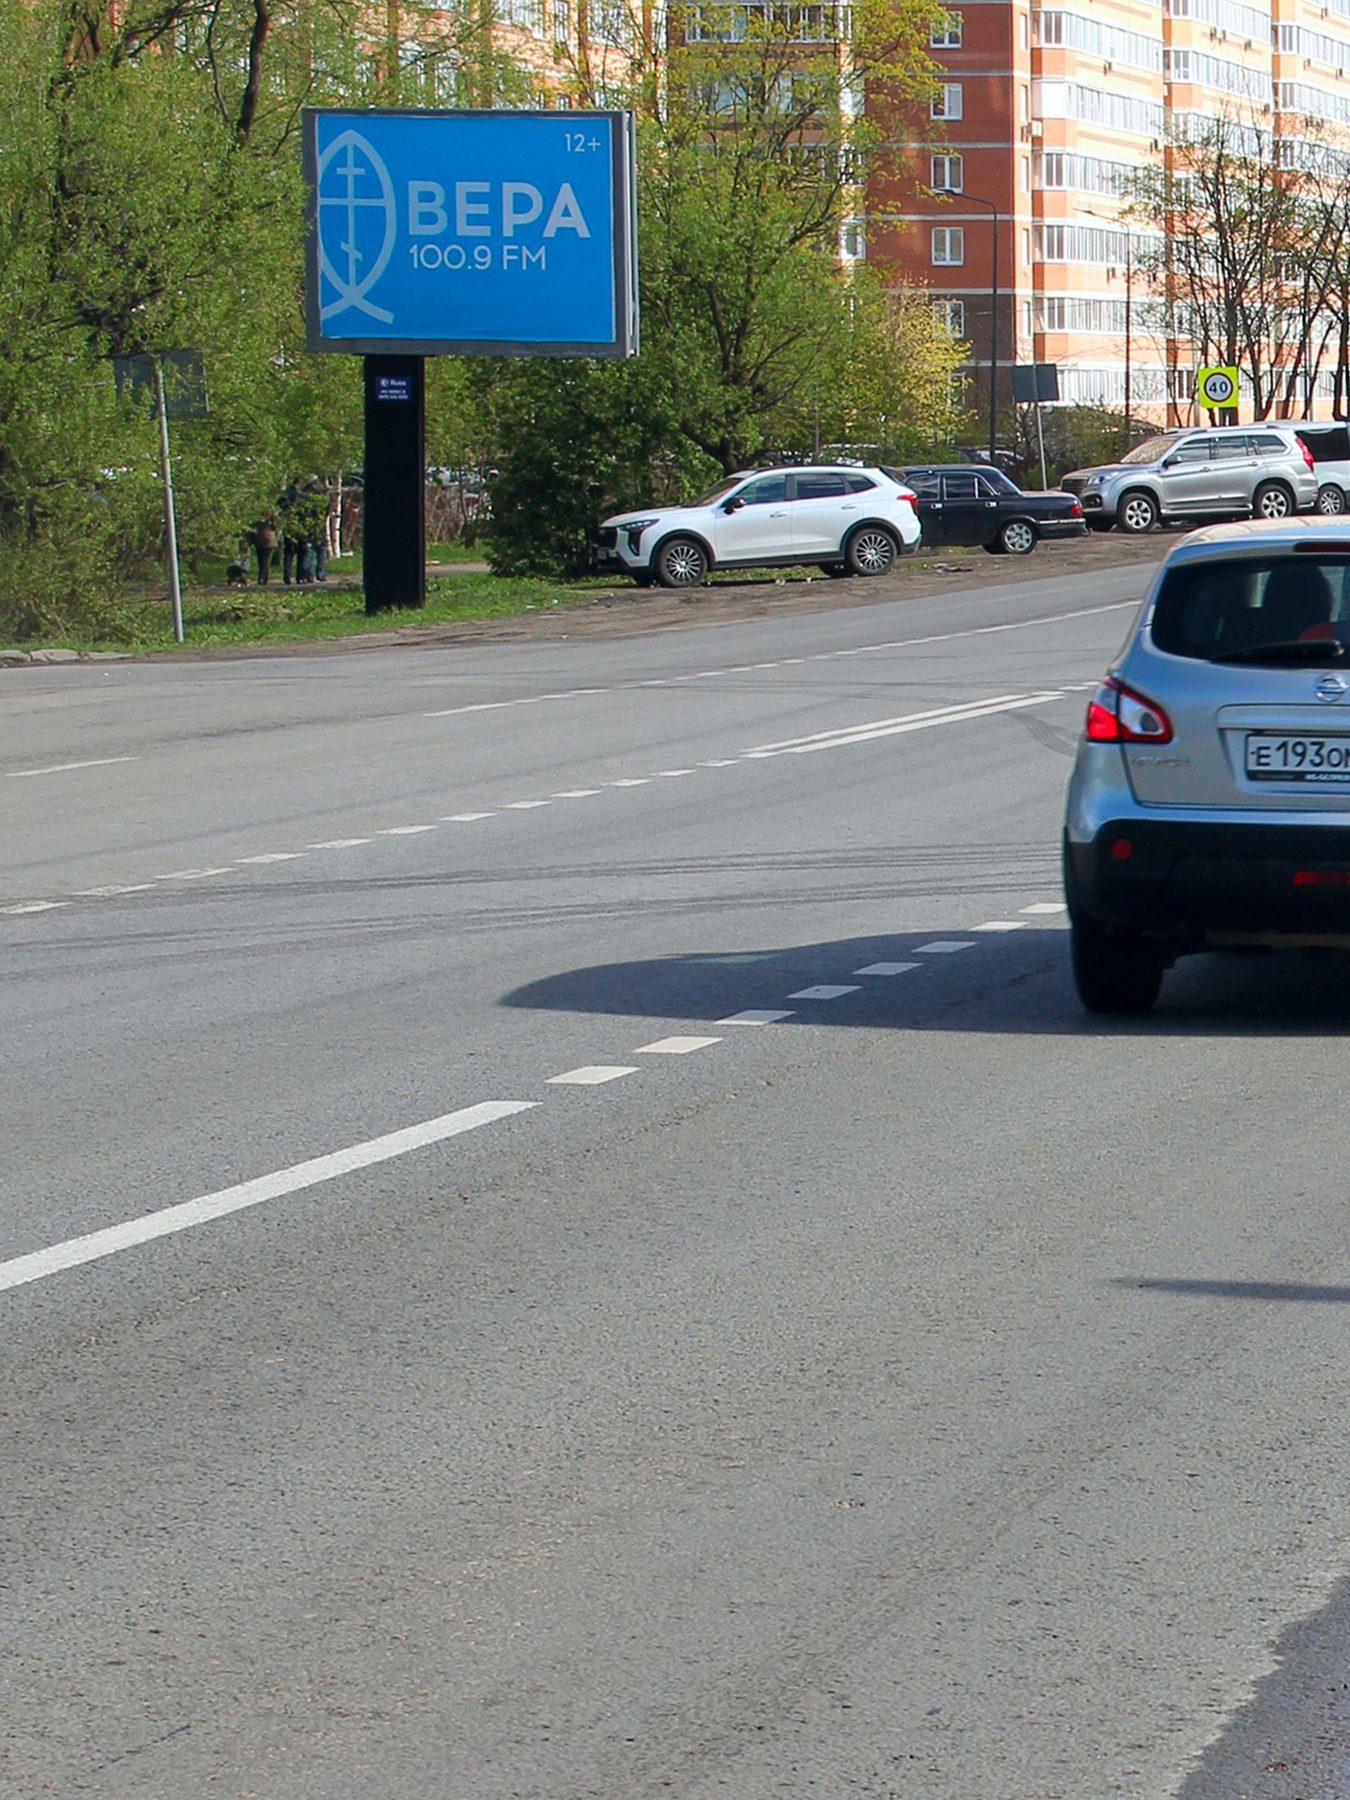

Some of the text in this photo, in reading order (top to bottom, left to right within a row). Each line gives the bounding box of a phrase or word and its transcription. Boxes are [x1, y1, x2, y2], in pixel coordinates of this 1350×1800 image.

[564, 133, 602, 153] 12+
[407, 180, 592, 239] ВЕРА
[409, 243, 547, 271] 100.9 FM
[1208, 380, 1229, 394] 40
